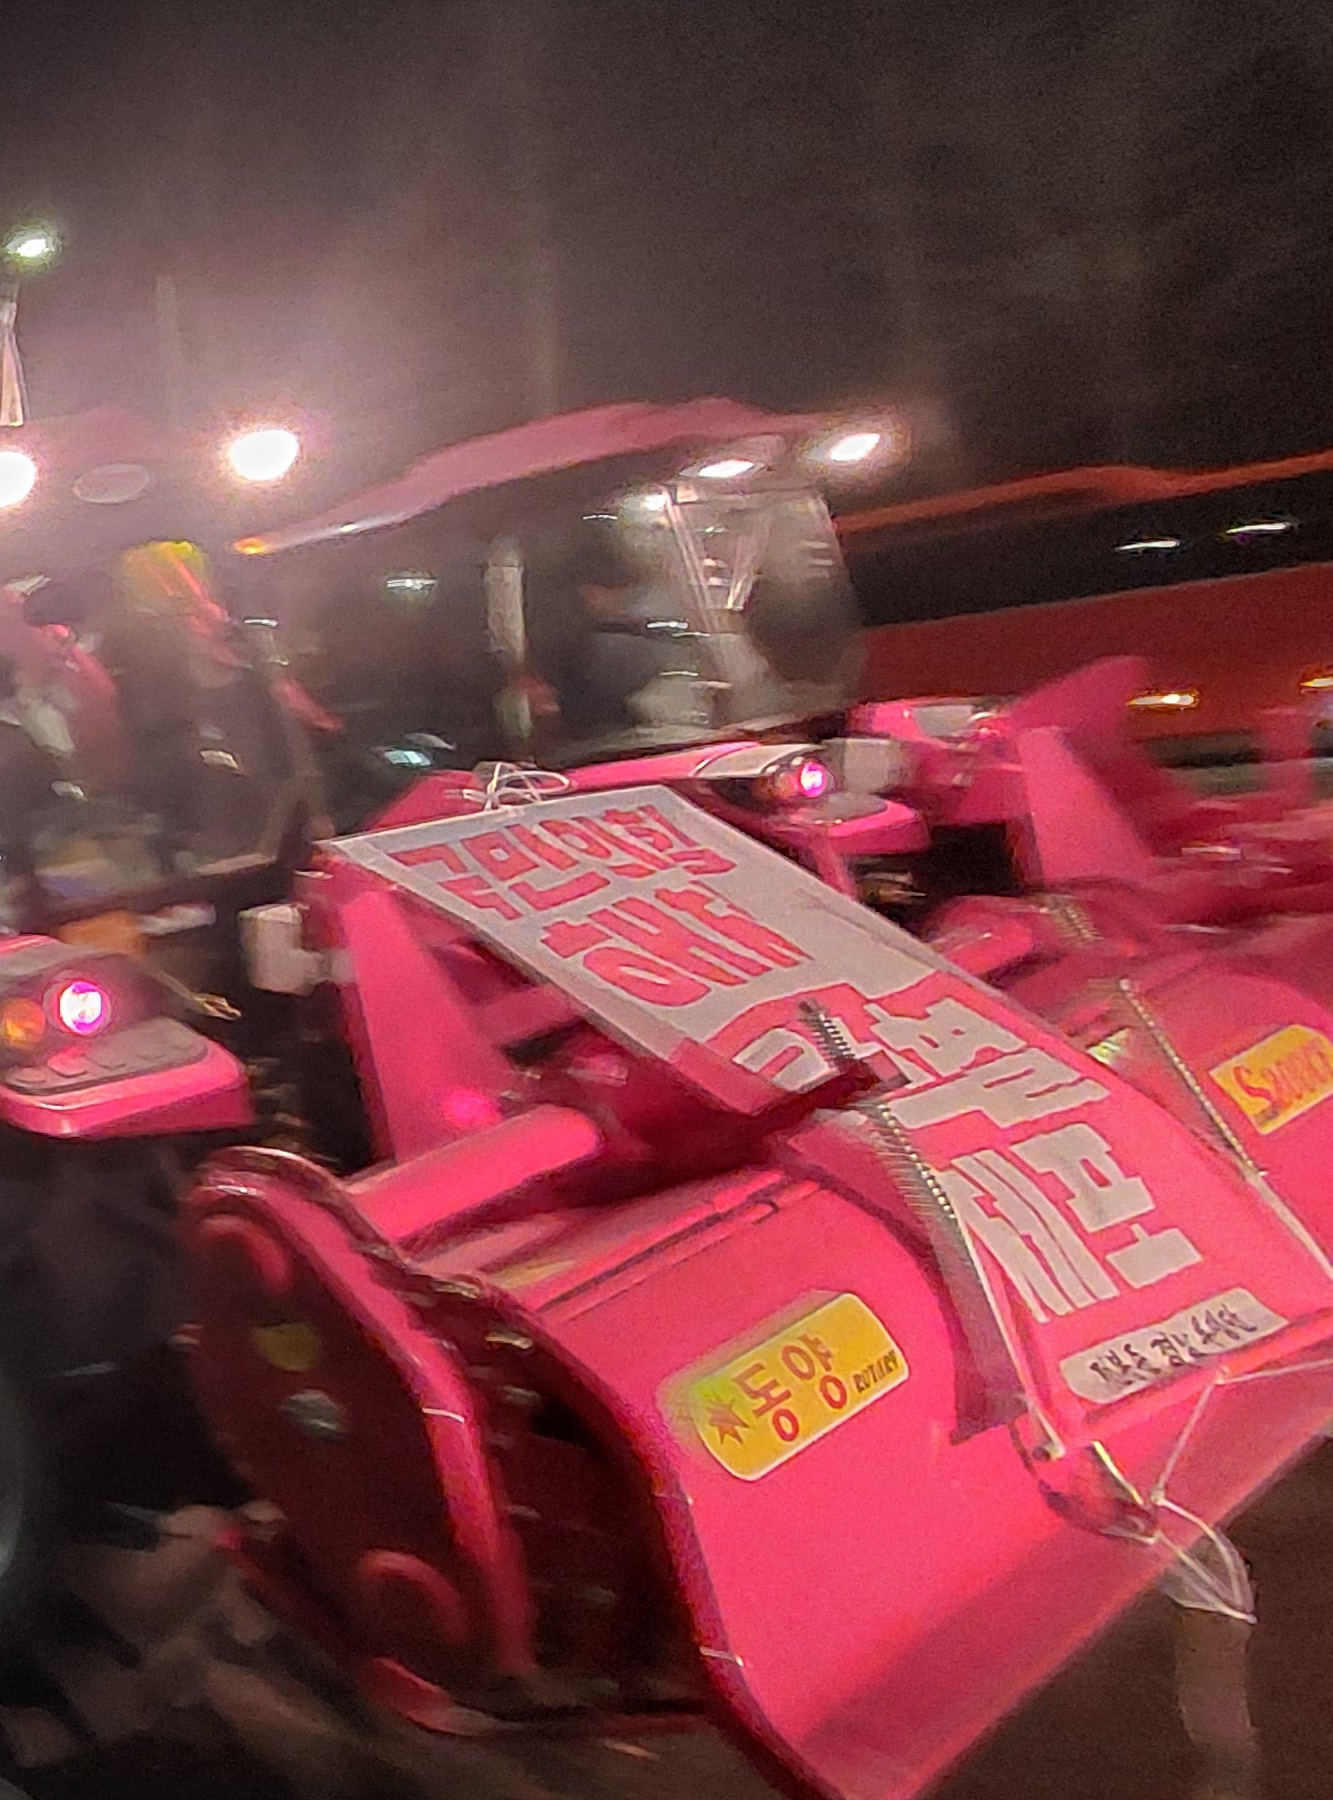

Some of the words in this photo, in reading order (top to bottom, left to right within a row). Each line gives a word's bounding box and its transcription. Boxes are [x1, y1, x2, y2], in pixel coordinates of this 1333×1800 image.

[388, 805, 737, 921] 국민의힘
[932, 1122, 1203, 1324] 체포
[731, 1333, 847, 1442] 동양
